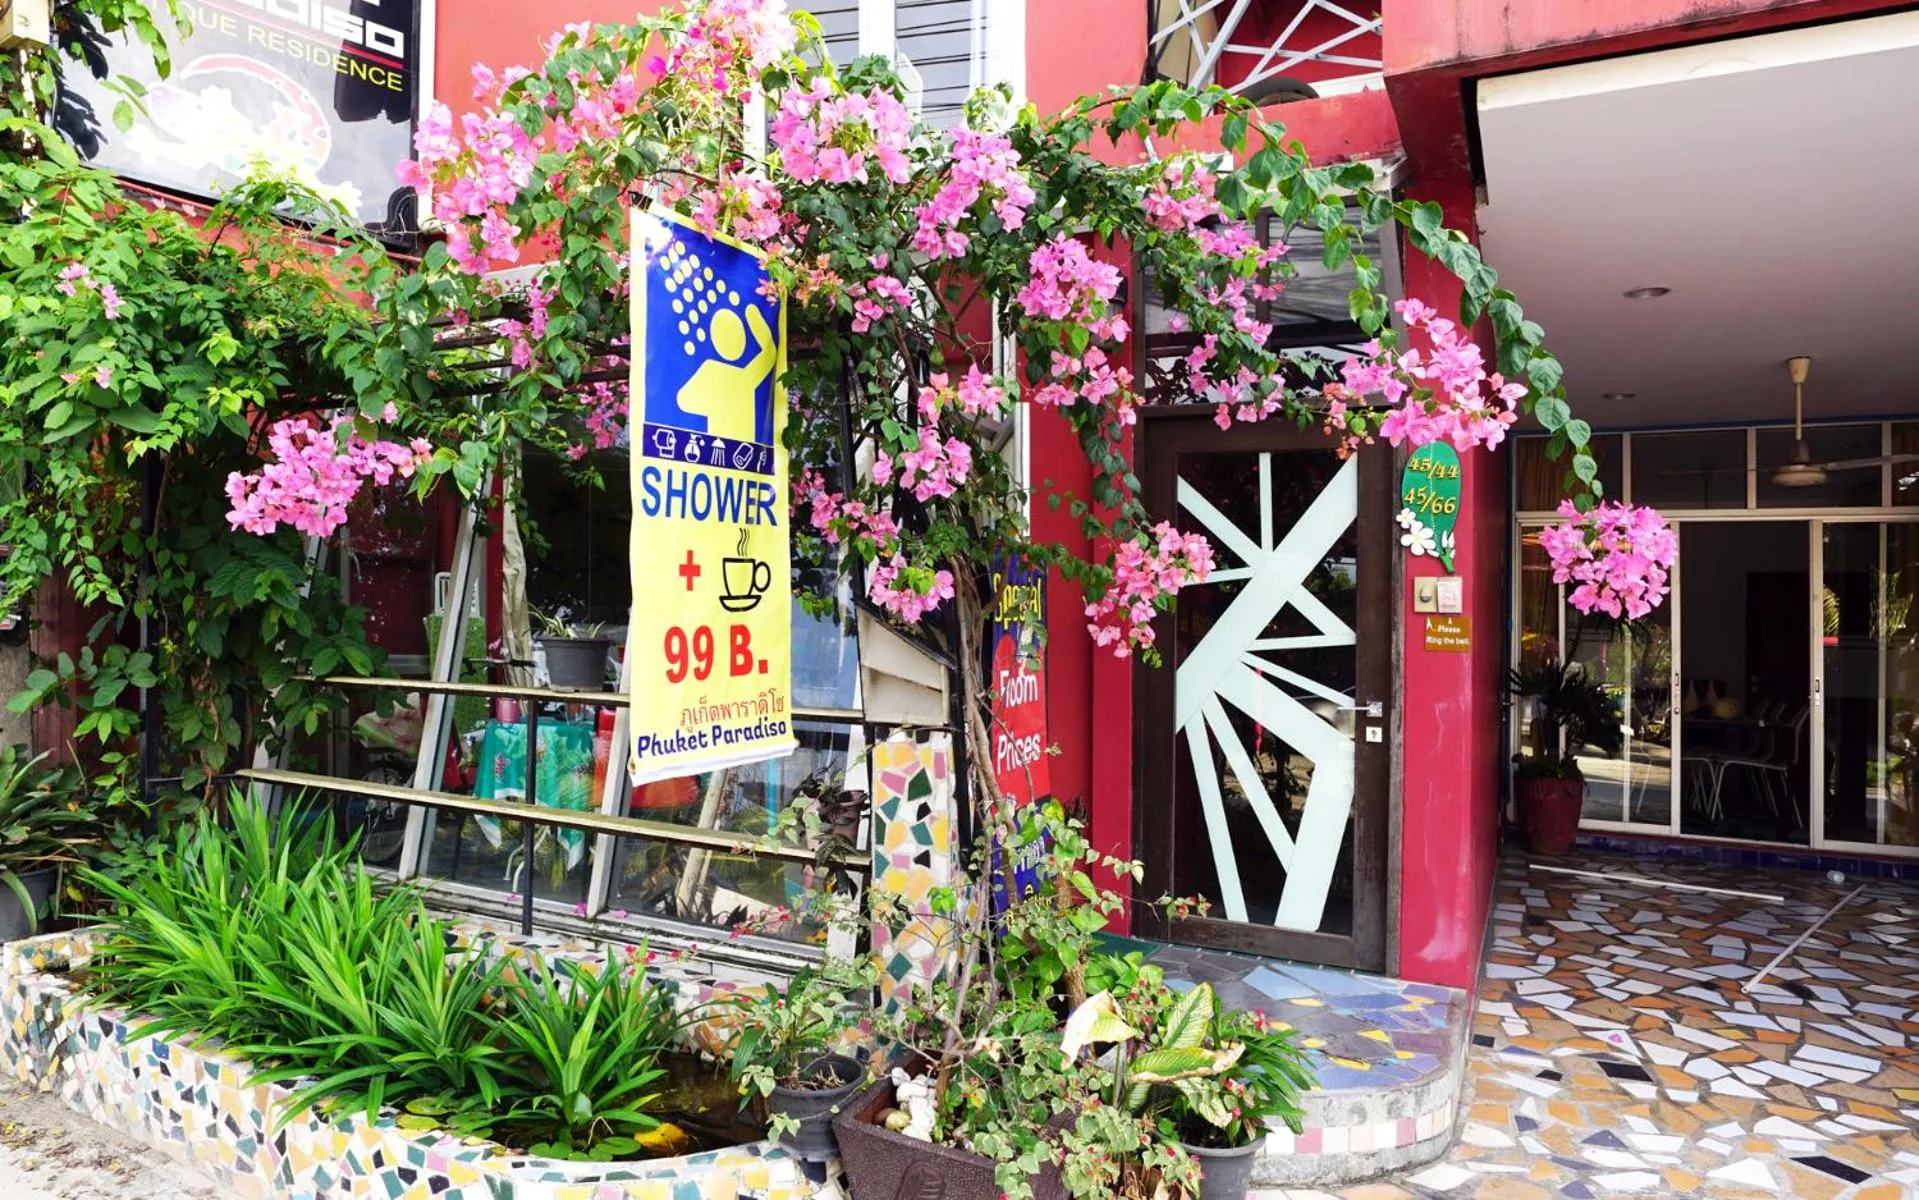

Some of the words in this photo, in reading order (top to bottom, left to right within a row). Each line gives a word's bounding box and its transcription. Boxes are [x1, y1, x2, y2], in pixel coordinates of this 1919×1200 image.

[247, 25, 404, 92] RESIDENCE
[1408, 456, 1458, 480] 45/44
[641, 466, 778, 527] SHOWER
[1404, 487, 1457, 514] 45/66
[664, 625, 715, 684] 99
[730, 624, 769, 677] B.
[637, 729, 708, 758] Phuket
[712, 716, 787, 747] Paradiso
